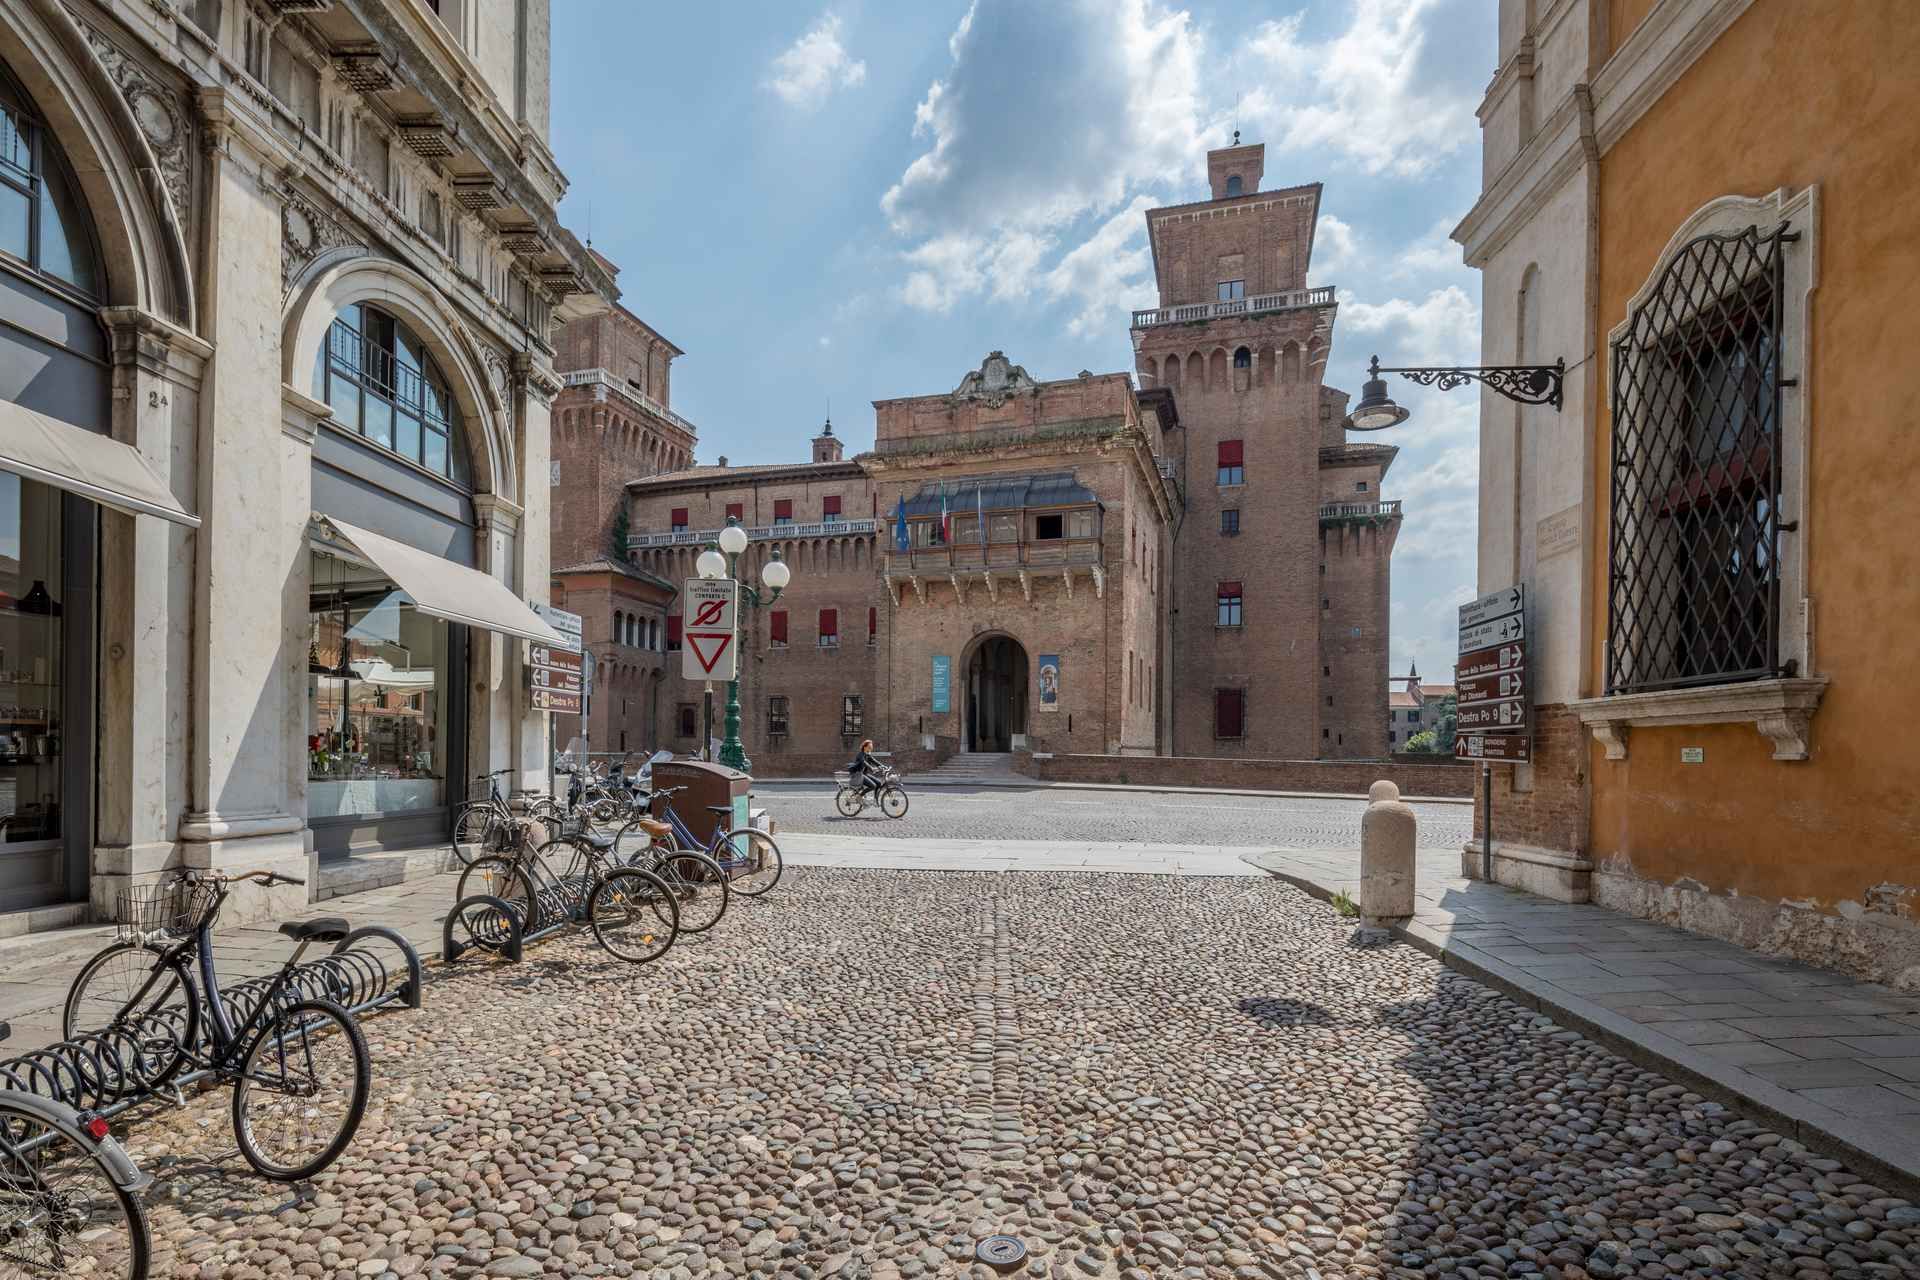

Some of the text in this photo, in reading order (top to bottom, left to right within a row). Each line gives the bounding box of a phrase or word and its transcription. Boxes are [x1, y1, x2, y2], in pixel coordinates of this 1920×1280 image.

[1459, 708, 1499, 723] Destra Po 9
